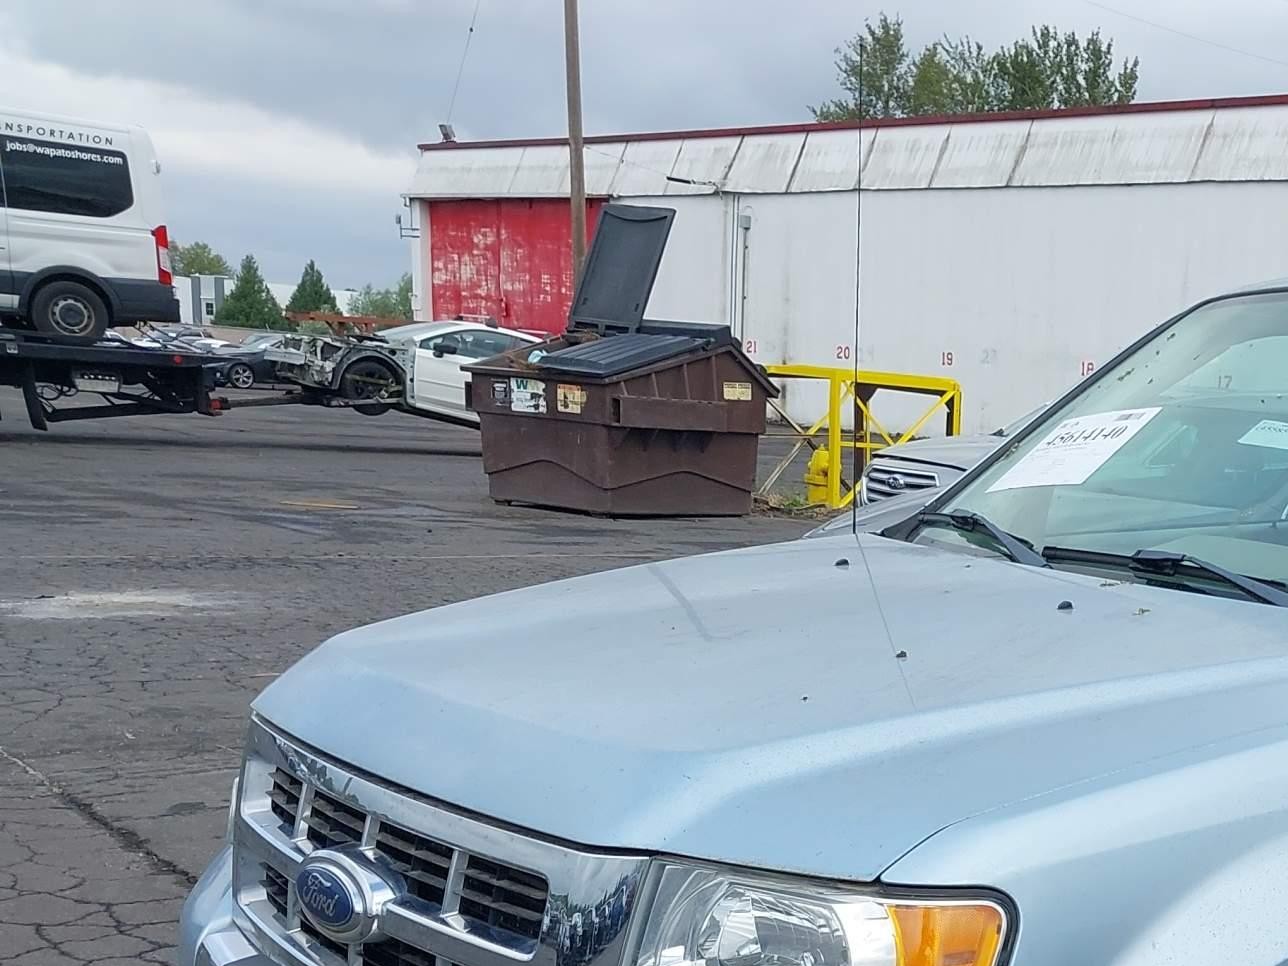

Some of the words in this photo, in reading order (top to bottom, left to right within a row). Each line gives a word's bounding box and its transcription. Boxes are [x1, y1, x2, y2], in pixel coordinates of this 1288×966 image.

[0, 122, 113, 146] NSPORTATION
[5, 140, 123, 165] jobs@wapatoshores.com
[746, 340, 757, 353] 21
[836, 346, 850, 359] 20
[942, 351, 953, 366] 19
[1218, 375, 1232, 390] 17
[302, 872, 340, 917] Ford
